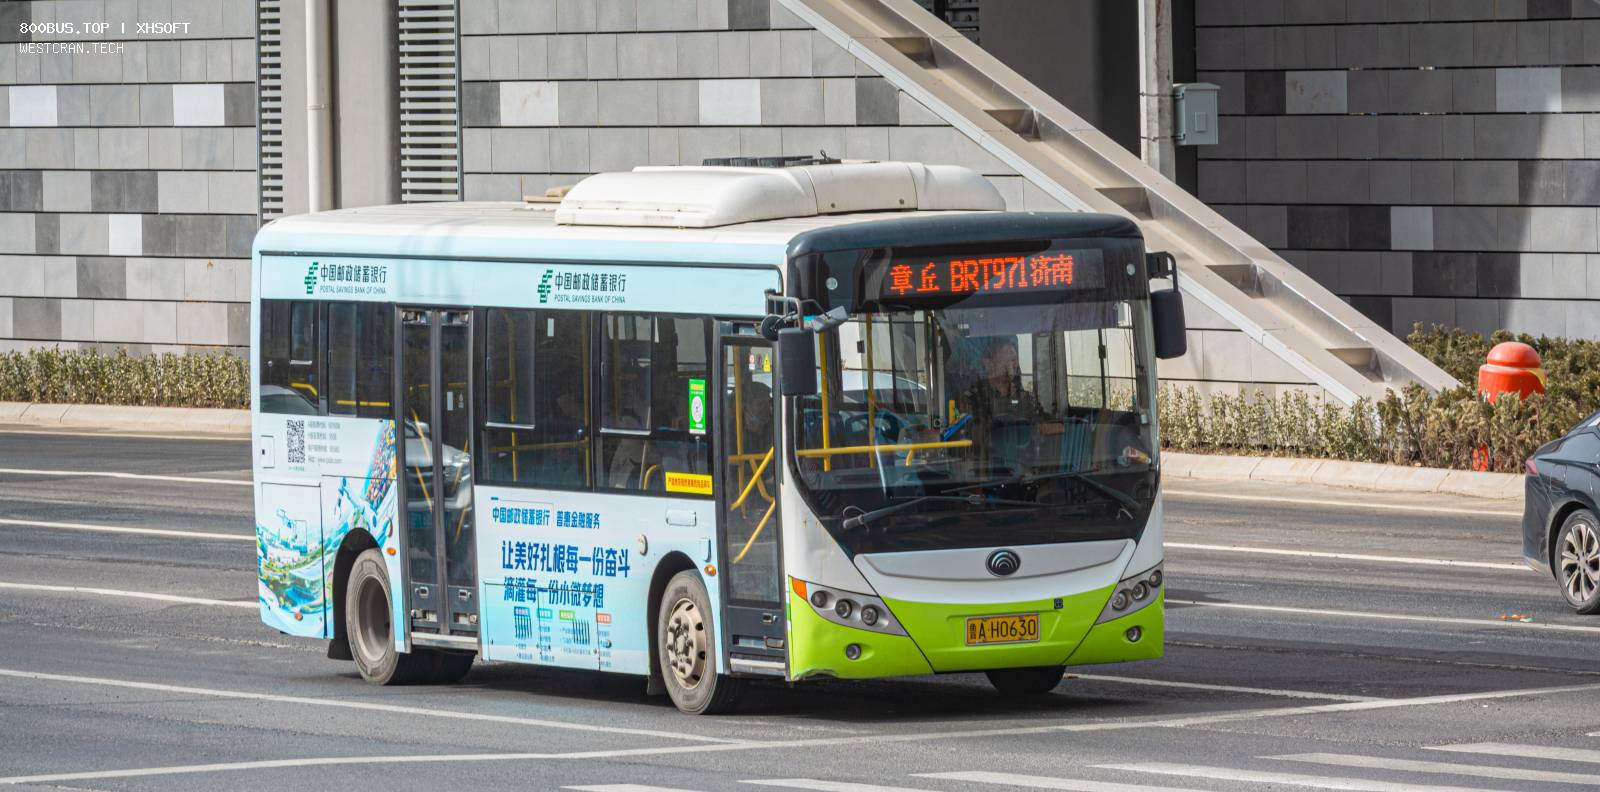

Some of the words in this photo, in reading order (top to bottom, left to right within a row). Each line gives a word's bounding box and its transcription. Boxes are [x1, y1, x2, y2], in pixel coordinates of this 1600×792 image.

[320, 264, 388, 283] 中国邮政储蓄银行
[554, 272, 627, 291] 中国邮政储蓄银行
[889, 261, 940, 295] 章丘
[354, 286, 366, 294] BANK
[373, 286, 386, 295] CHINA
[554, 294, 571, 303] POSTAL
[572, 294, 591, 303] SAVINGS
[591, 295, 604, 304] BANK
[604, 295, 611, 304] OF
[612, 296, 626, 304] CHINA
[492, 506, 551, 527] 中国邮政储蓄银行
[556, 510, 601, 530] 普惠金融服务
[501, 539, 631, 579] 让美好扎根每一份奋斗
[503, 576, 605, 609] 滴灌每一份小微梦想
